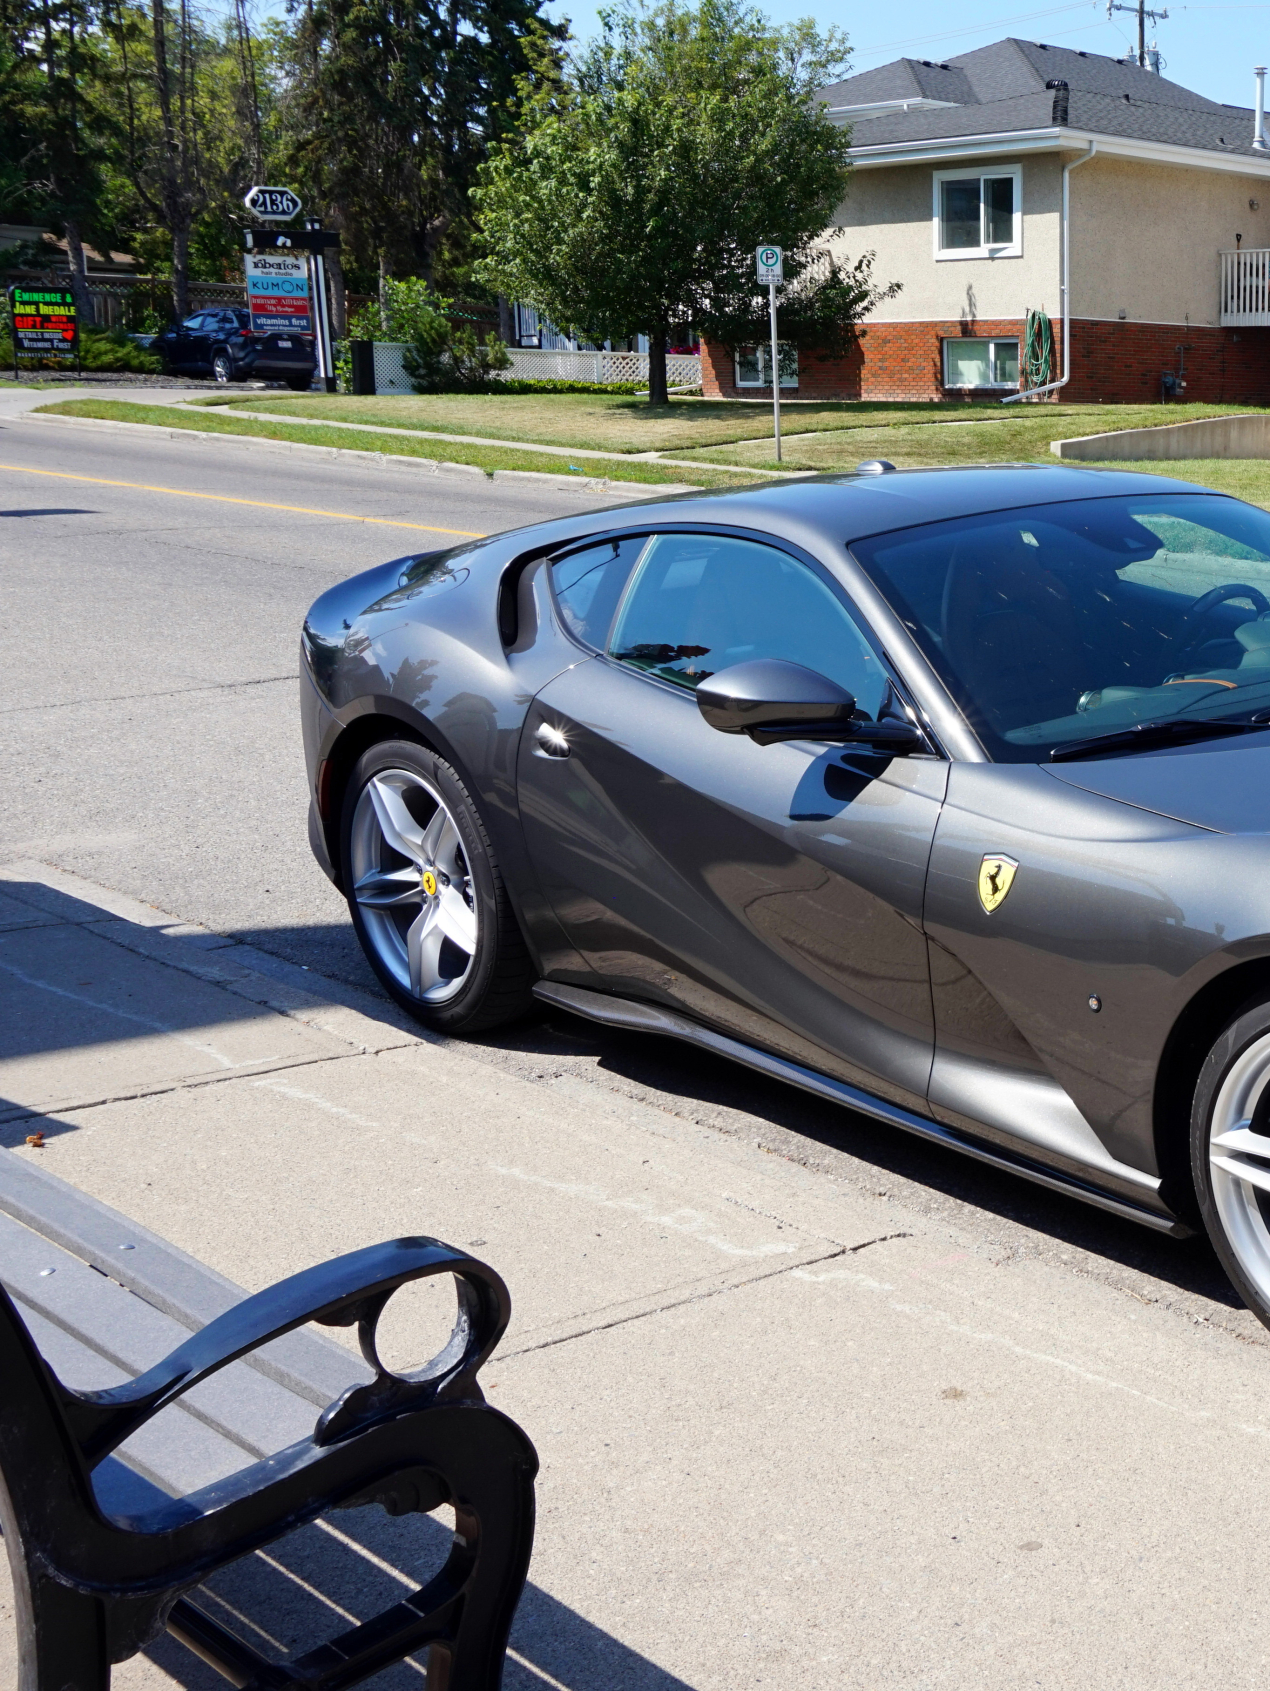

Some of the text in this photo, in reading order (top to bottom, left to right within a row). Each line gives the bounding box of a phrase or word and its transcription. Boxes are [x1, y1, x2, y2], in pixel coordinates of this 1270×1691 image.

[254, 192, 294, 212] 2136
[766, 252, 774, 263] P
[252, 280, 304, 294] KUMON
[14, 289, 72, 302] EMINENCE &
[14, 302, 76, 315] JANE IREDALE
[15, 316, 42, 329] GIFT
[256, 317, 307, 326] vitamins first
[22, 339, 71, 348] VITAMINS FIRST
